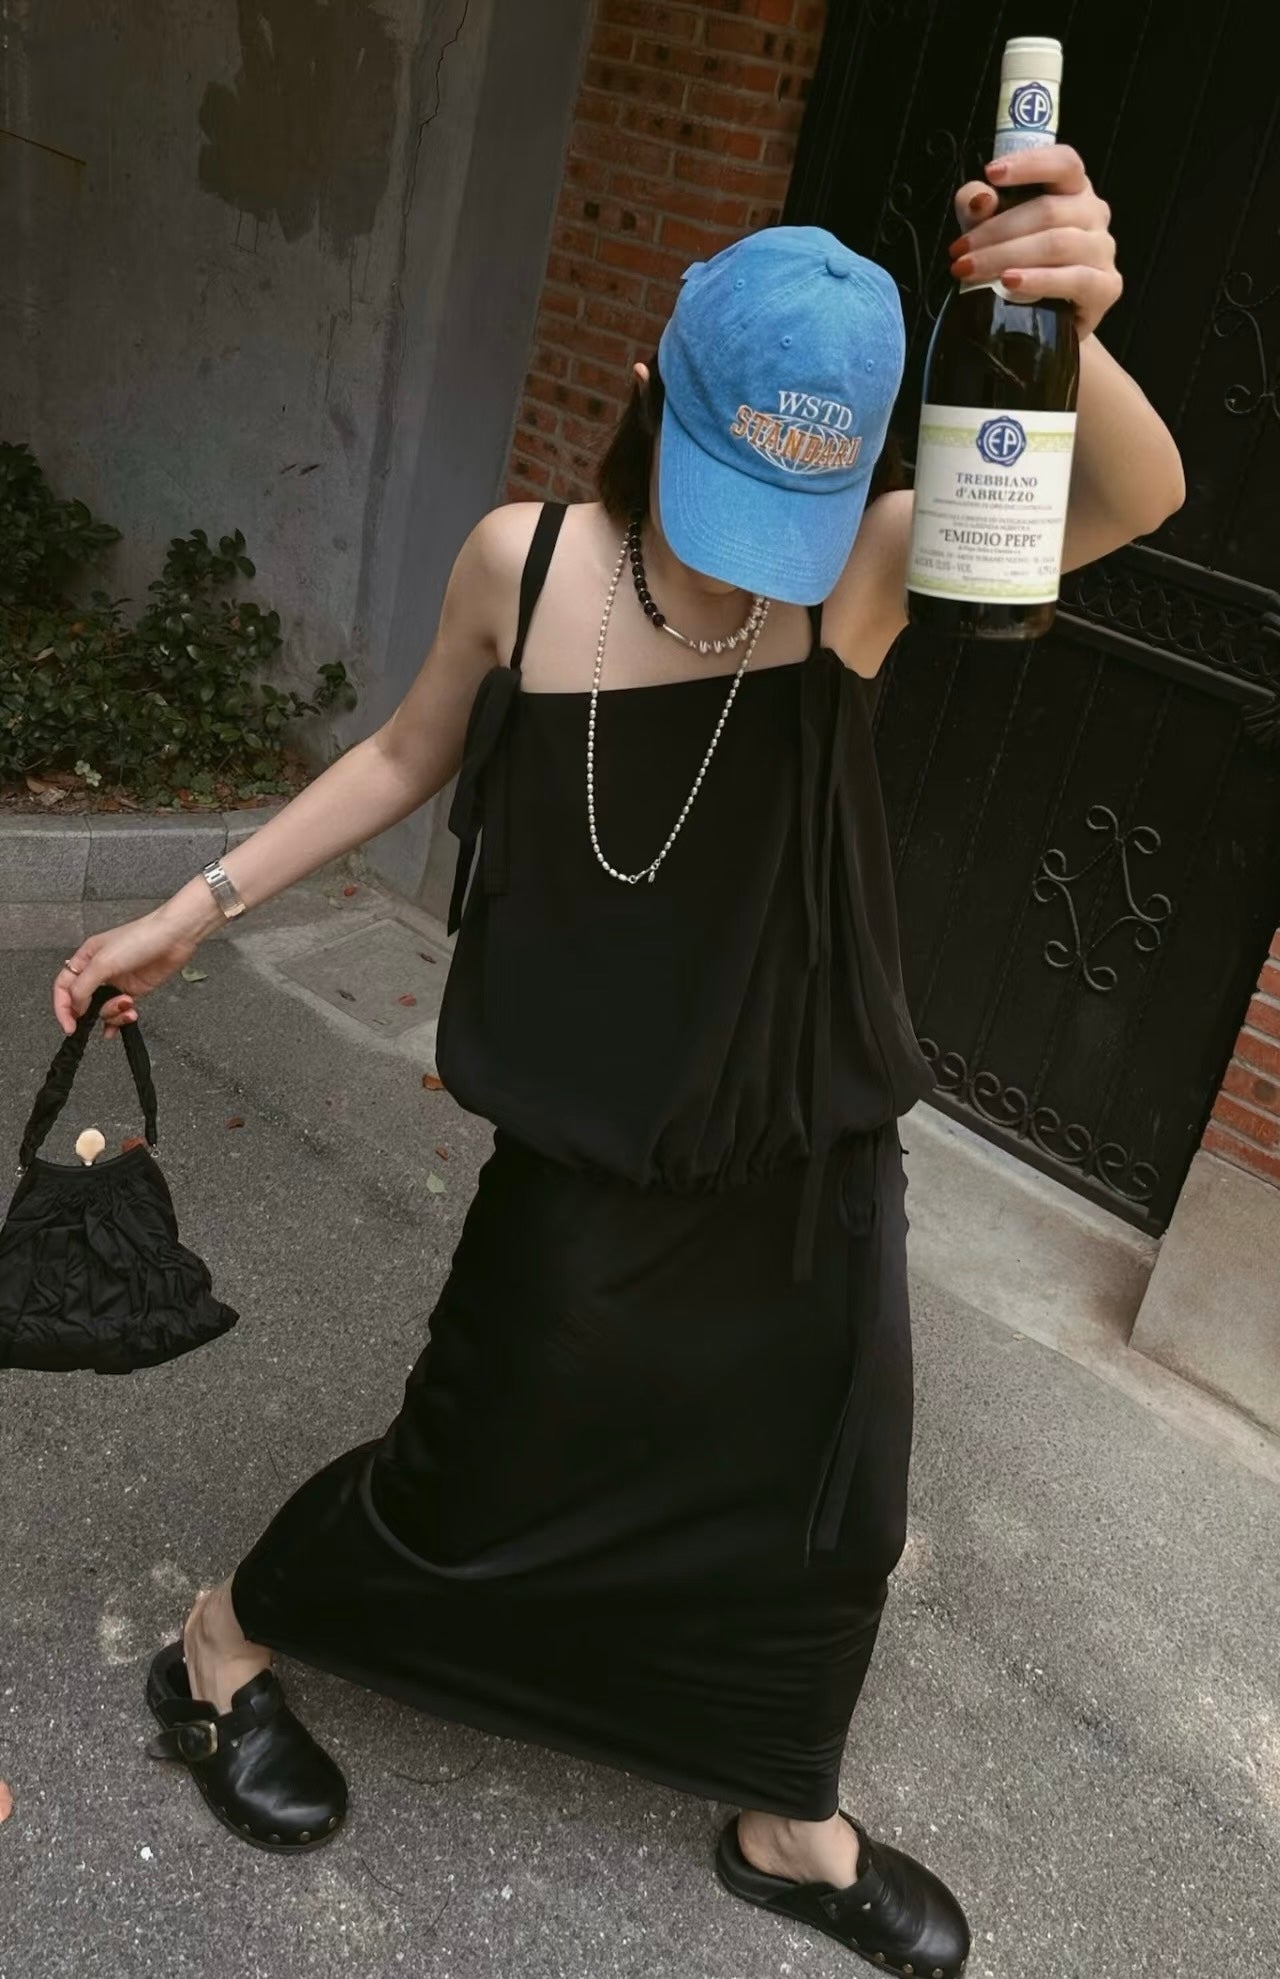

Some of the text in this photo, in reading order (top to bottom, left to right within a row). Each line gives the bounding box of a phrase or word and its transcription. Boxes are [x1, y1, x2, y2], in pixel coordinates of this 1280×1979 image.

[778, 390, 853, 431] WSTD
[956, 472, 1038, 487] TREBBIANO
[955, 487, 1035, 502] d'ABRUZZO
